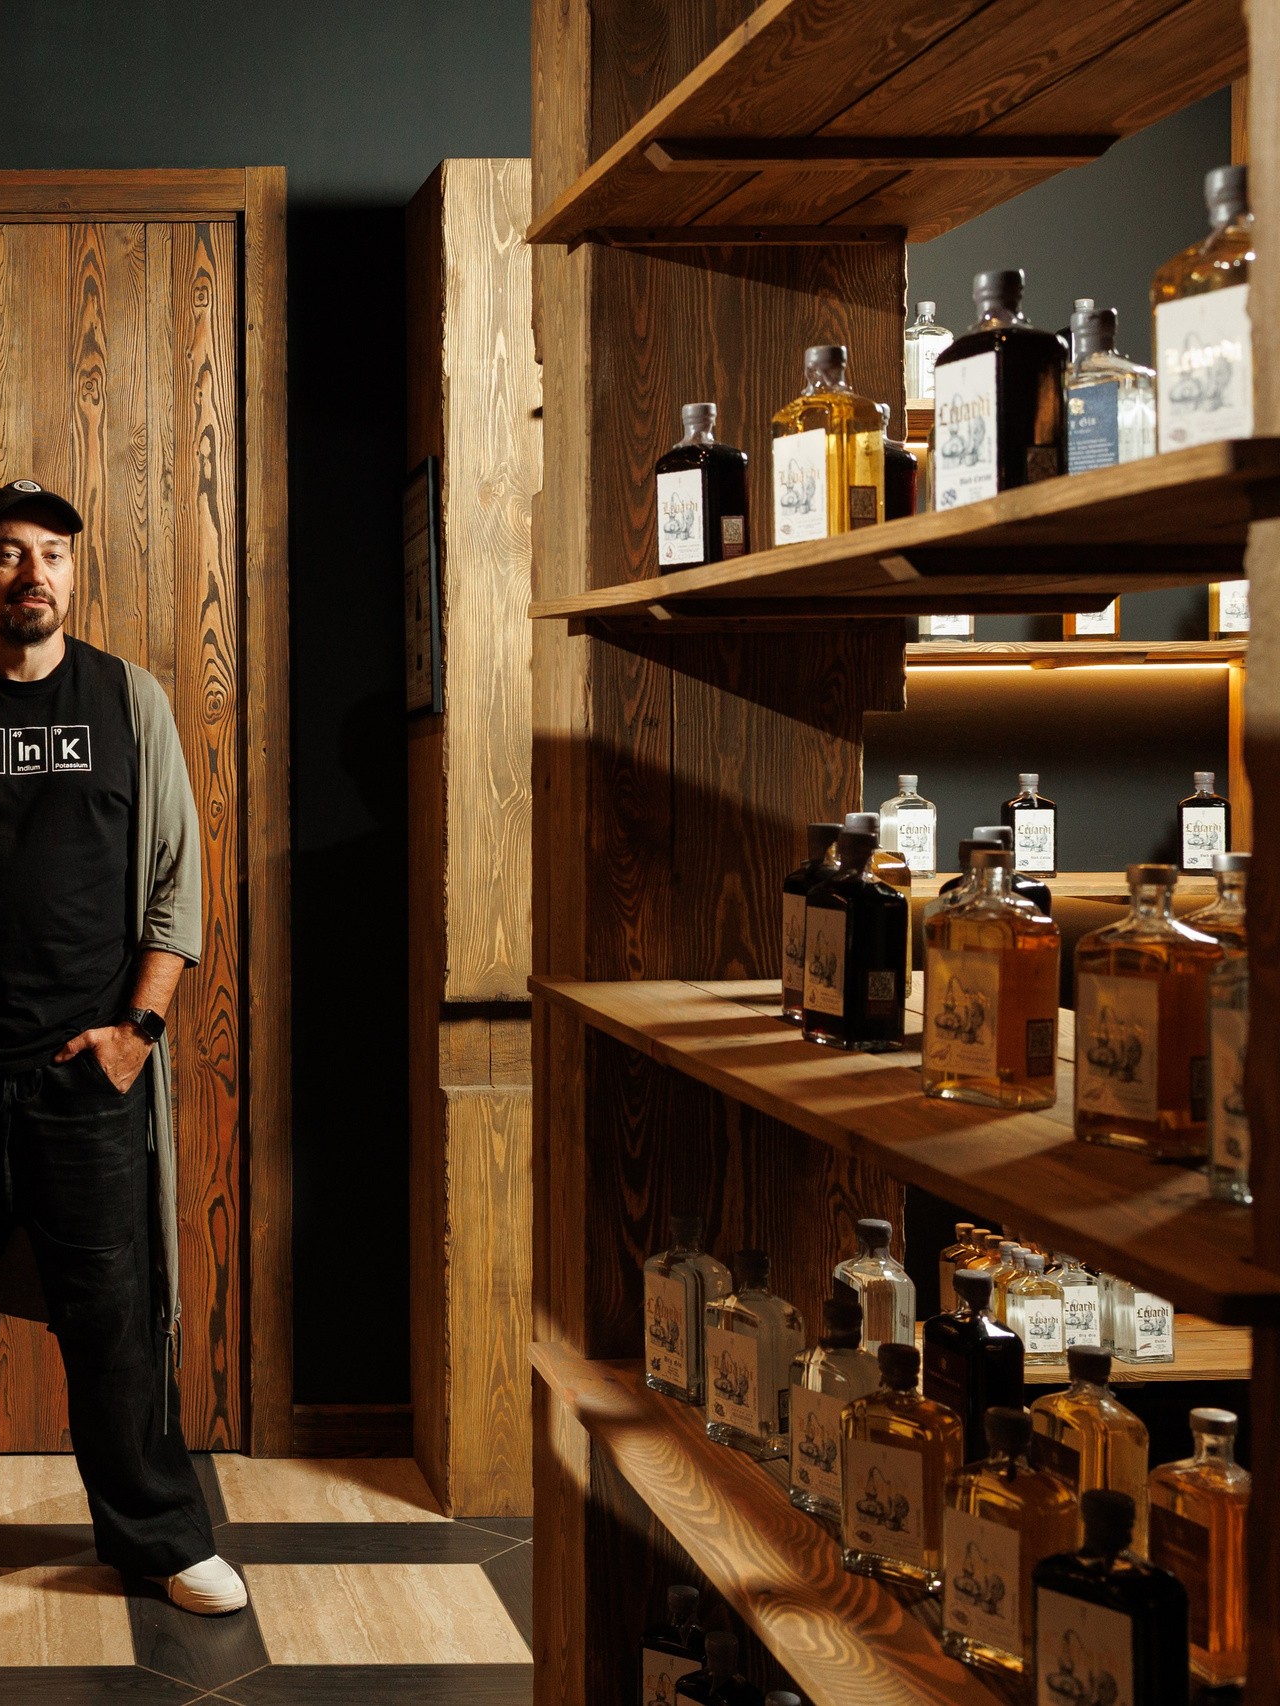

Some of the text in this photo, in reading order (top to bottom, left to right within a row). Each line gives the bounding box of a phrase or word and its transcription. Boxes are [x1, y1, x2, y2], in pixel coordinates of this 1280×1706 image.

[12, 730, 22, 738] 49
[53, 728, 62, 736] 19
[18, 741, 41, 762] In
[62, 738, 81, 760] K
[17, 764, 41, 772] Indium
